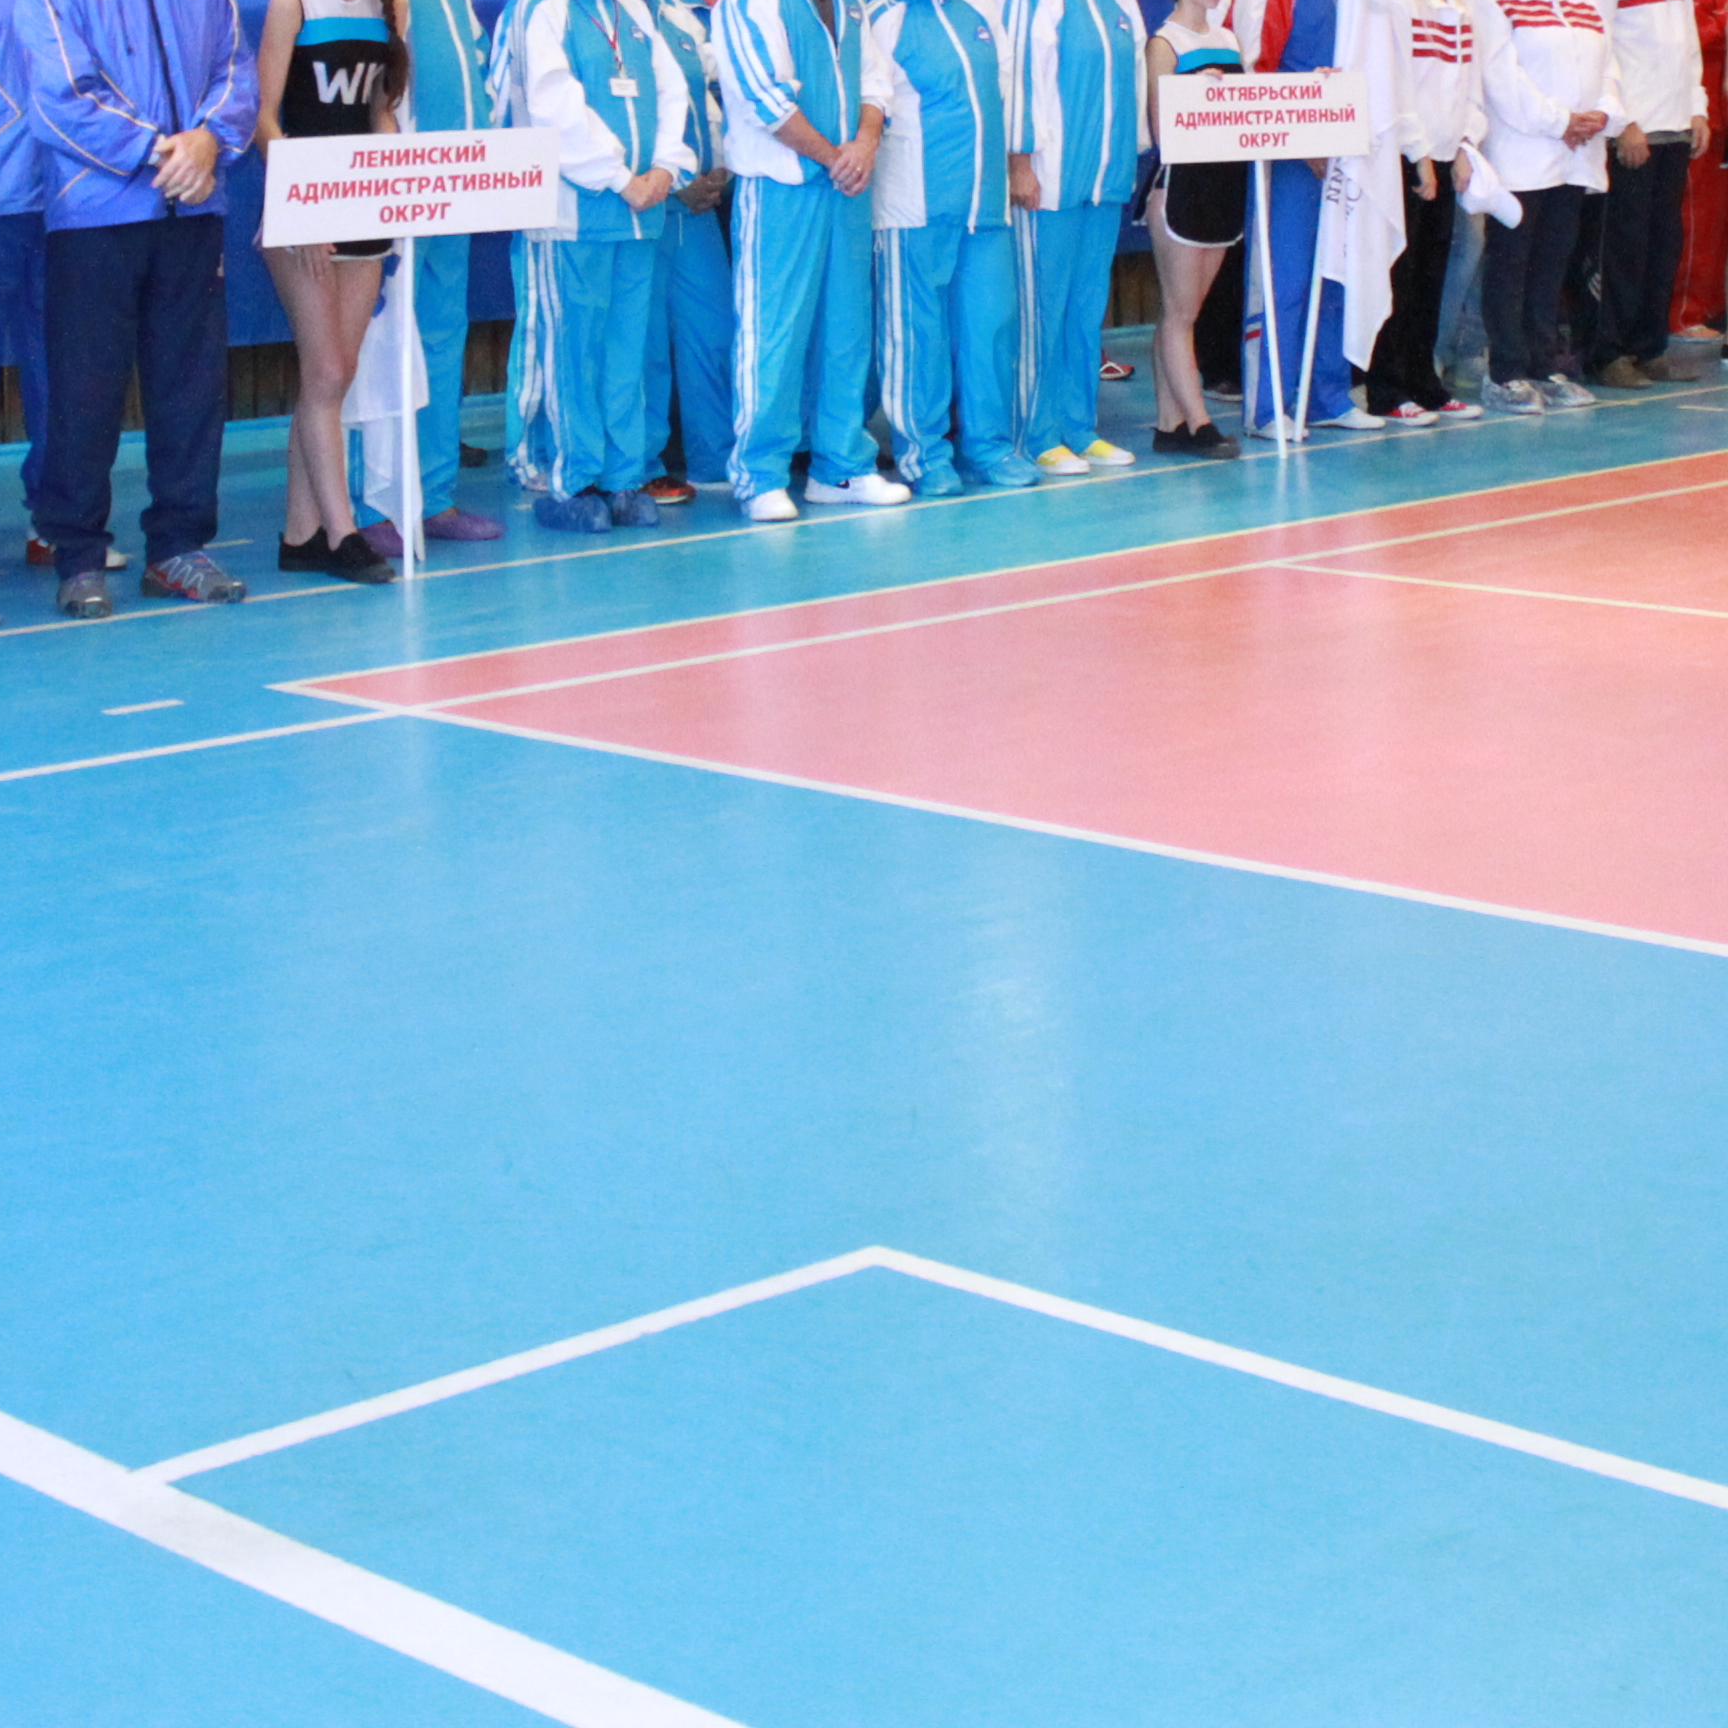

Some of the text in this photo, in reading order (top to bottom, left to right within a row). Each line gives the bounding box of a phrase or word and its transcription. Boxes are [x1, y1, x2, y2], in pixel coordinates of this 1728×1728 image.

[1205, 81, 1322, 102] ОКТЯБРЬСКИЙ
[1174, 103, 1356, 130] АДМИНИСТРАТИВНЫЙ
[1239, 132, 1290, 148] ОКРУГ
[349, 140, 487, 170] ЛЕНИНСКИЙ
[286, 165, 543, 204] АДМИНИСТРАТИВНЫЙ
[379, 202, 452, 224] ОКРУГ
